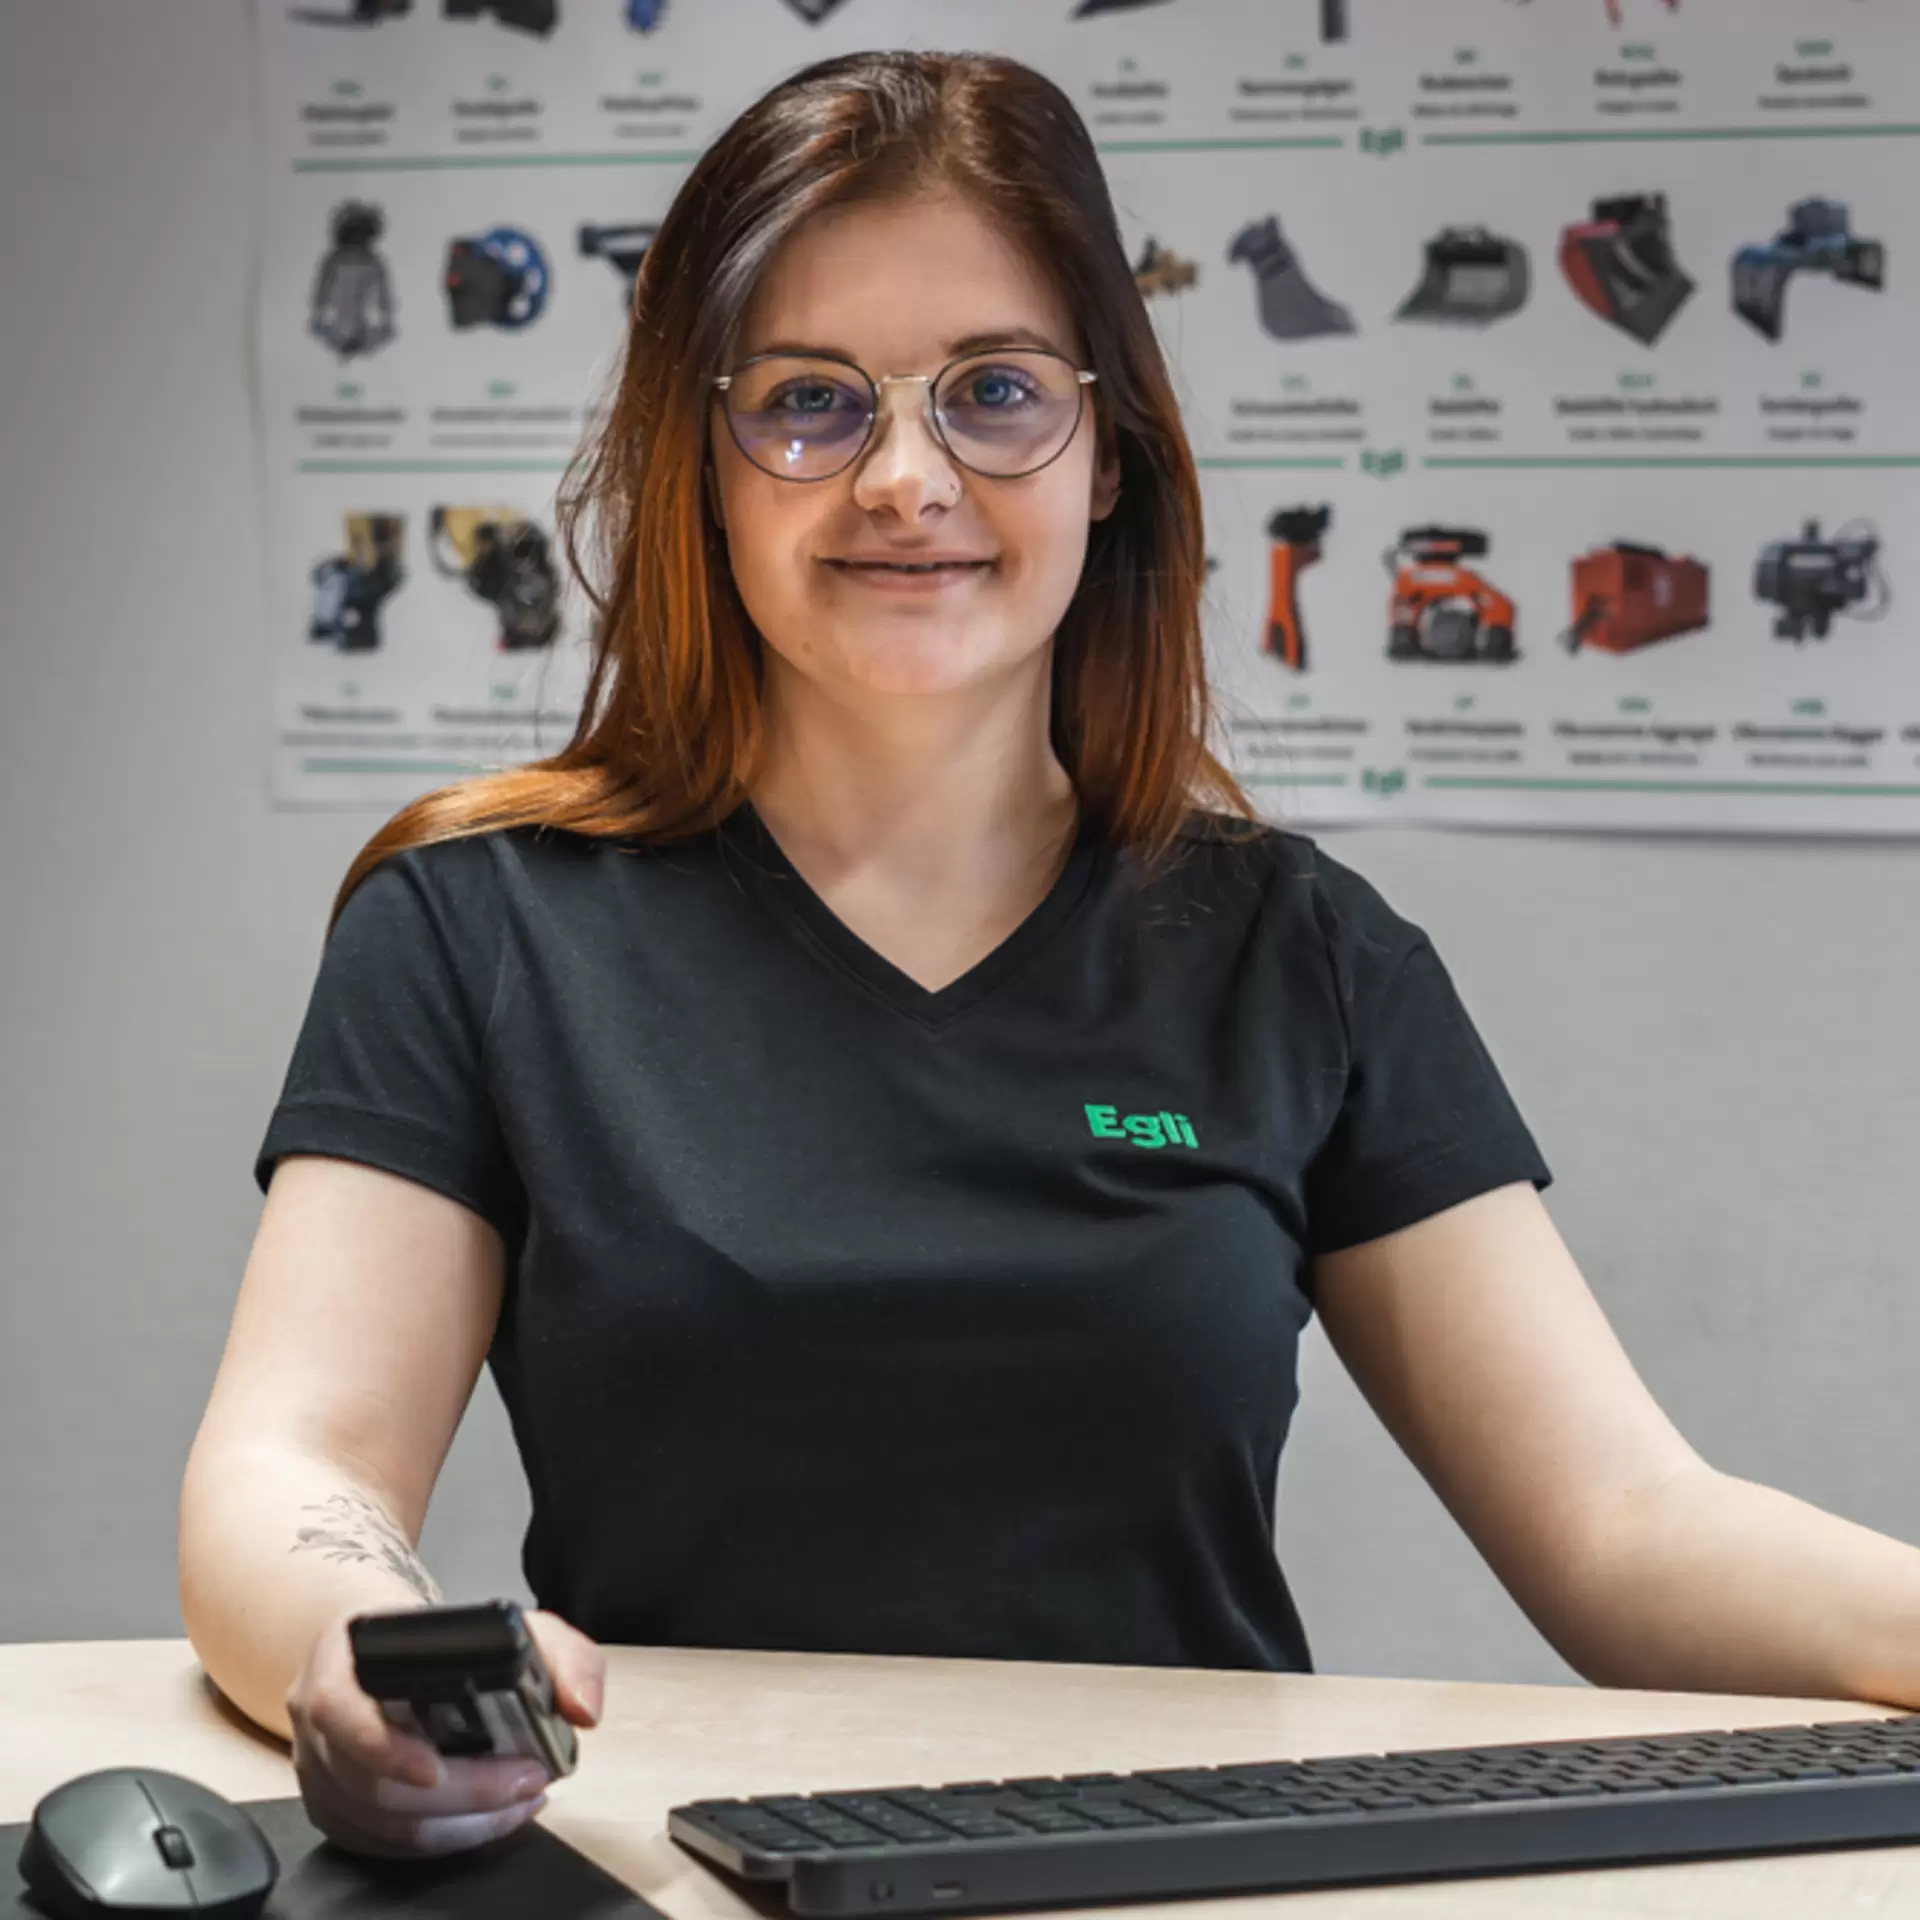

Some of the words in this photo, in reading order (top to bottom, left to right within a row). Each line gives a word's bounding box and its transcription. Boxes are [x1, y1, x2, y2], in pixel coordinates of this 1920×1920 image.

[1360, 128, 1405, 156] Egli
[1362, 769, 1405, 796] Egli
[1084, 1104, 1199, 1149] Egli
